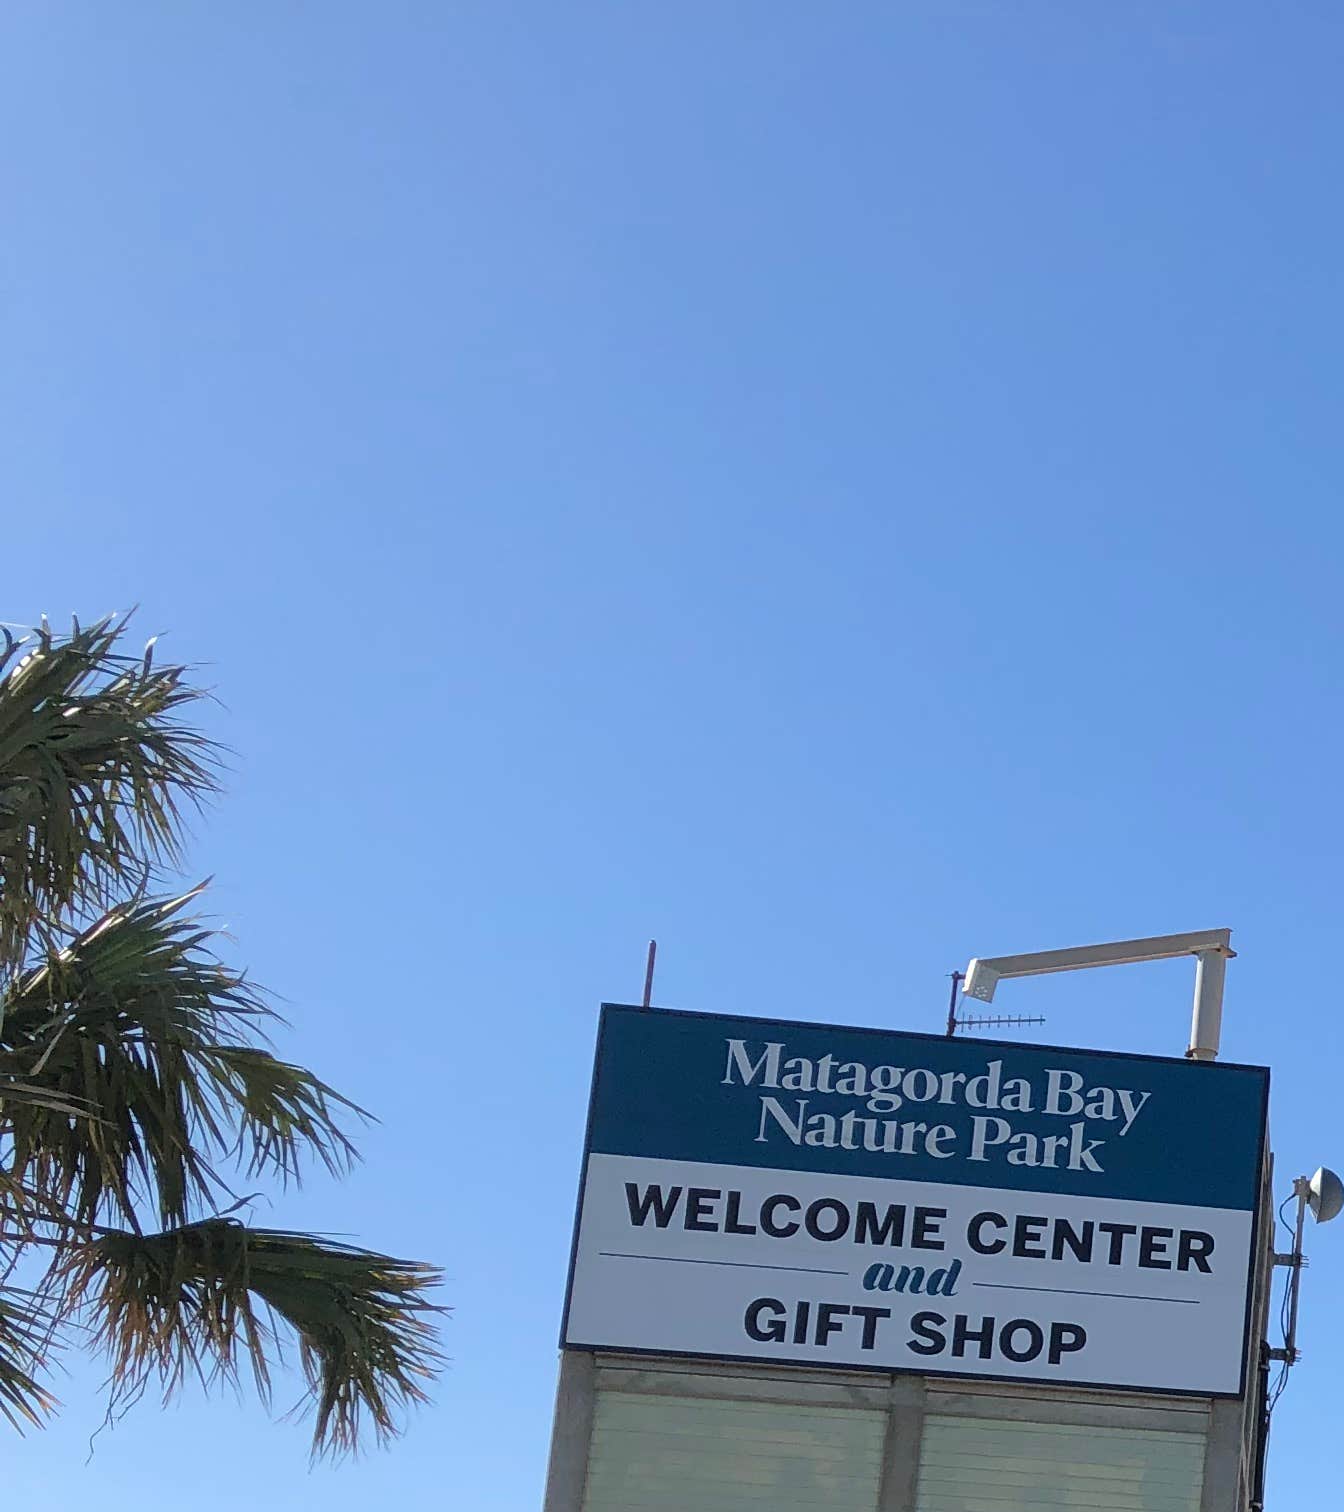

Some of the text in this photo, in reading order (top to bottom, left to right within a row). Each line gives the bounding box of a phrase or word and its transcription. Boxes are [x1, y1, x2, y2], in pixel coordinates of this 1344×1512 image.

[720, 1038, 1152, 1136] Matagorda Bay
[754, 1096, 1105, 1173] Nature Park
[624, 1182, 1216, 1274] WELCOME CENTER
[862, 1259, 963, 1297] and
[744, 1298, 1088, 1366] GIFT SHOP
